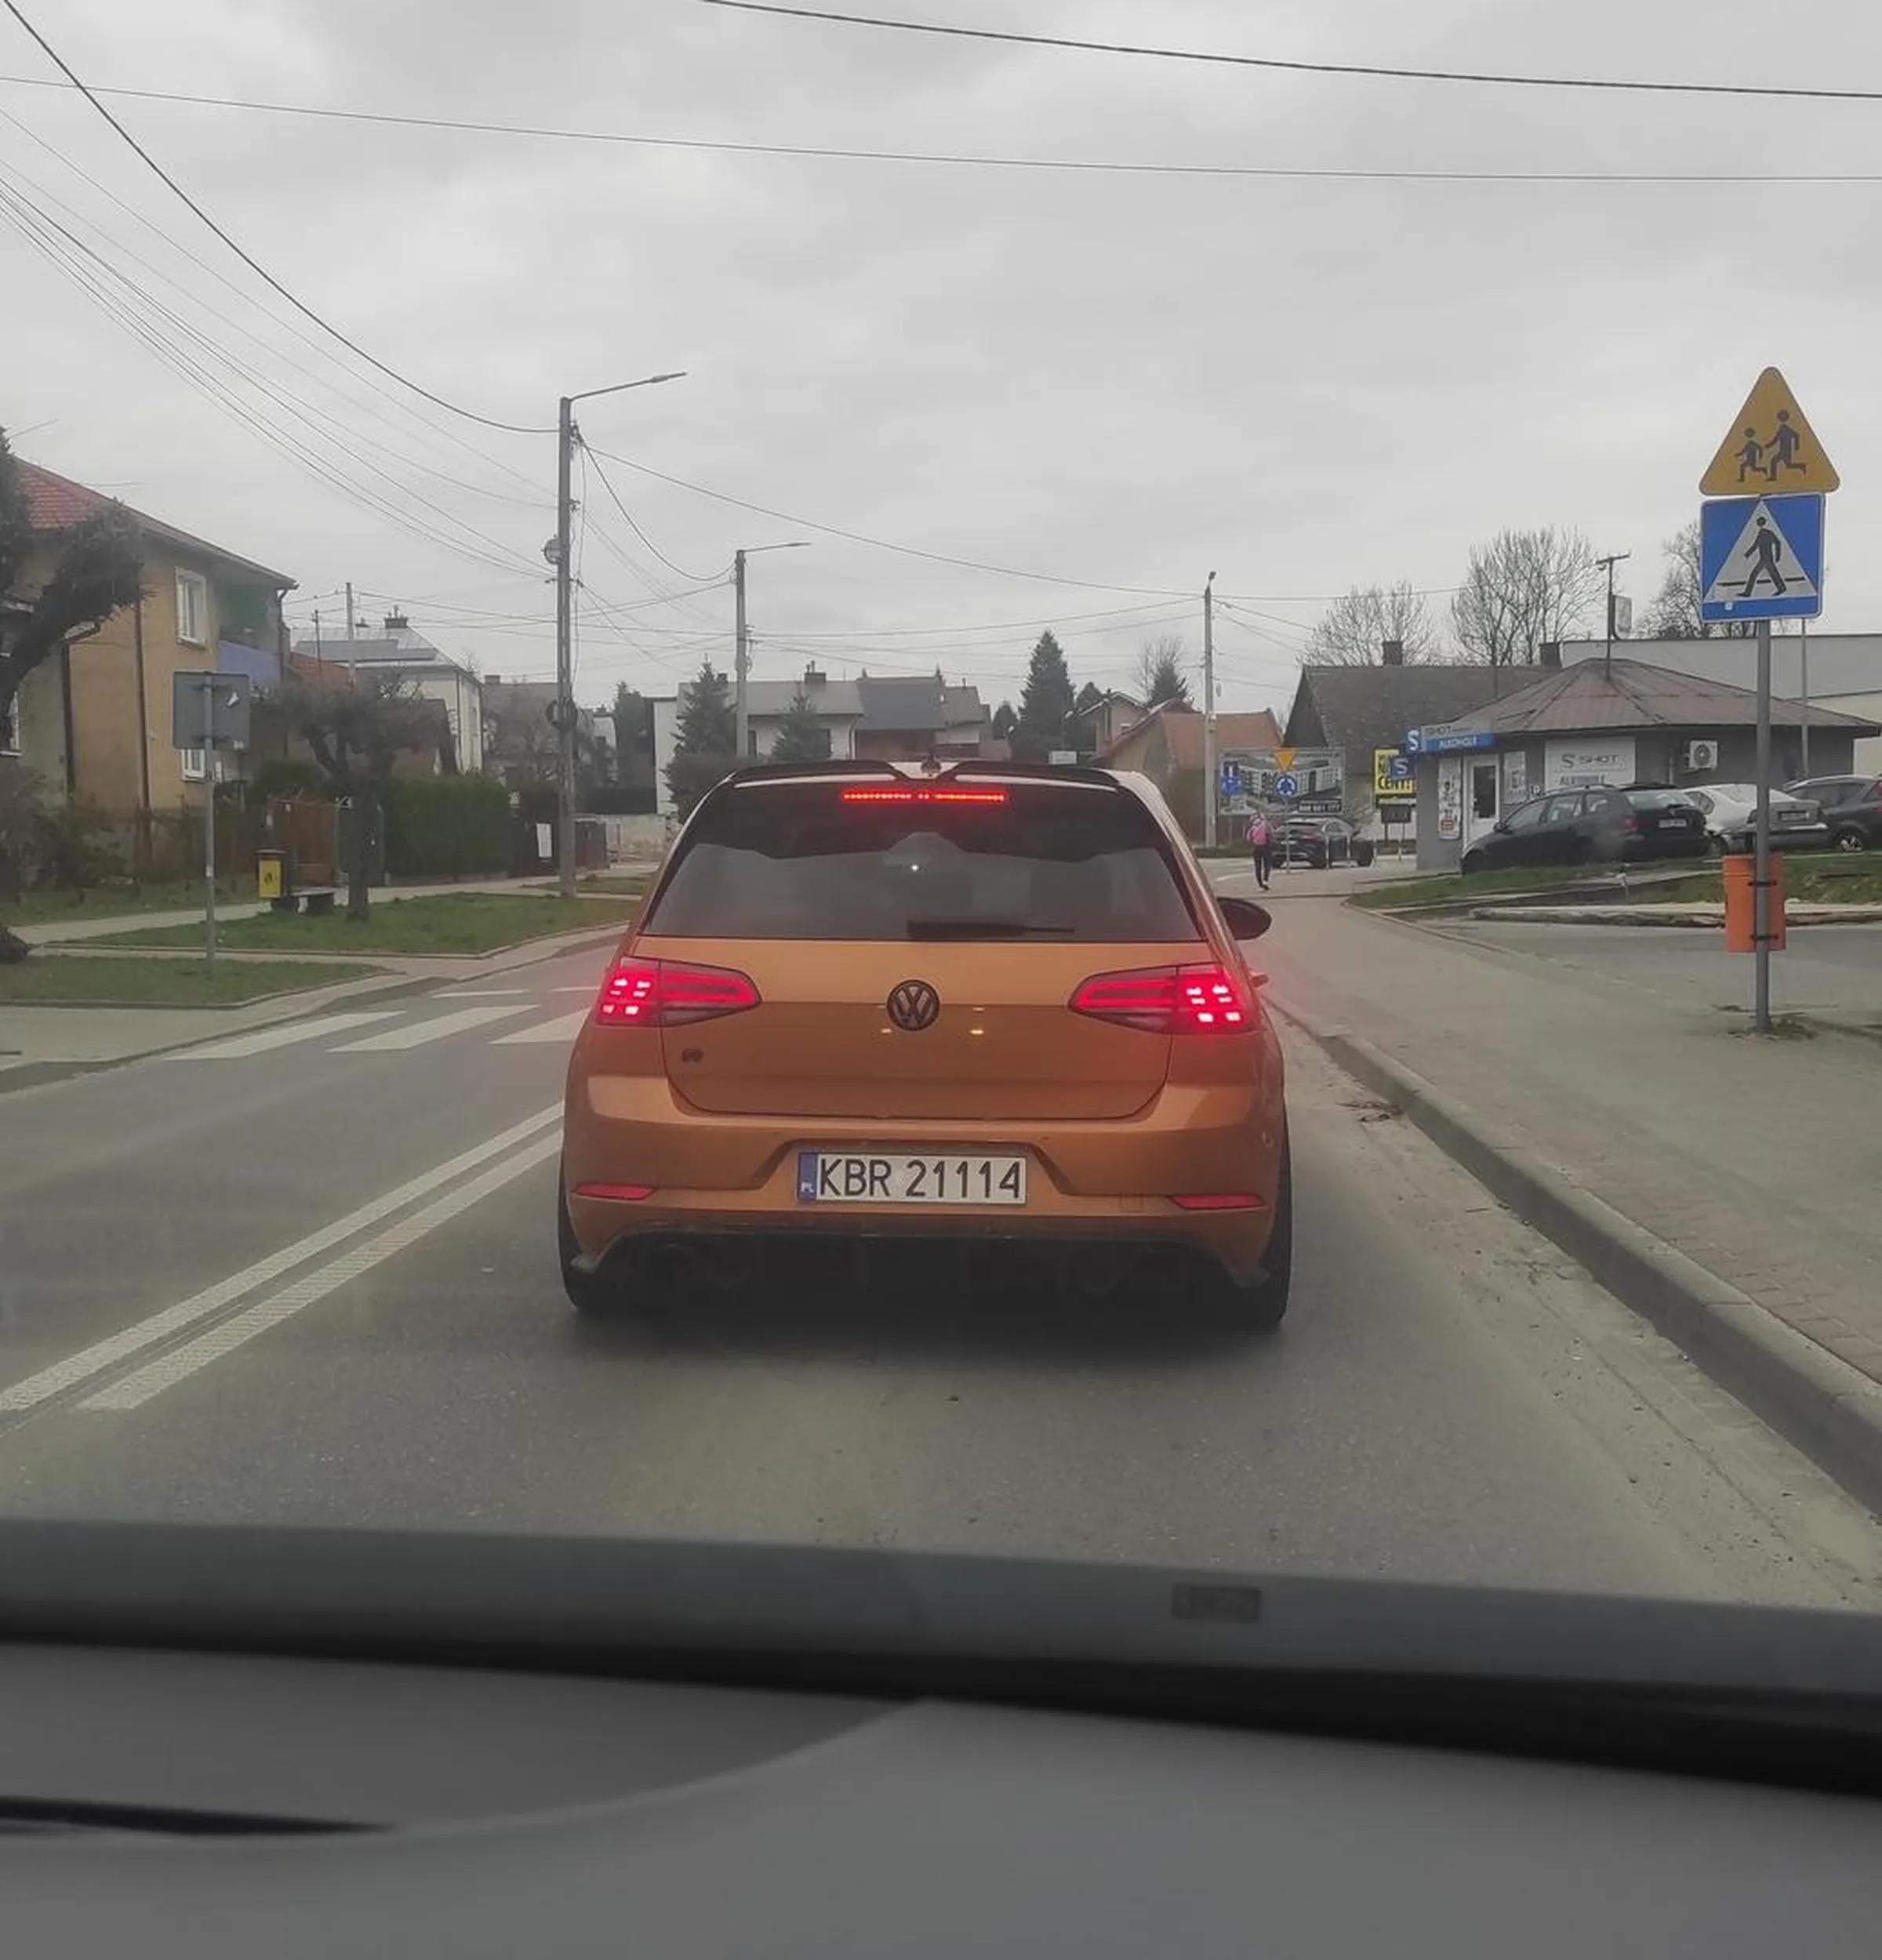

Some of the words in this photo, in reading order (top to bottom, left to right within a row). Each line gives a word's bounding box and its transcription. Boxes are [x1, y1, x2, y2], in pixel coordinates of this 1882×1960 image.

[1393, 758, 1409, 775] S
[819, 1158, 892, 1198] KBR
[905, 1159, 1021, 1200] 21114
